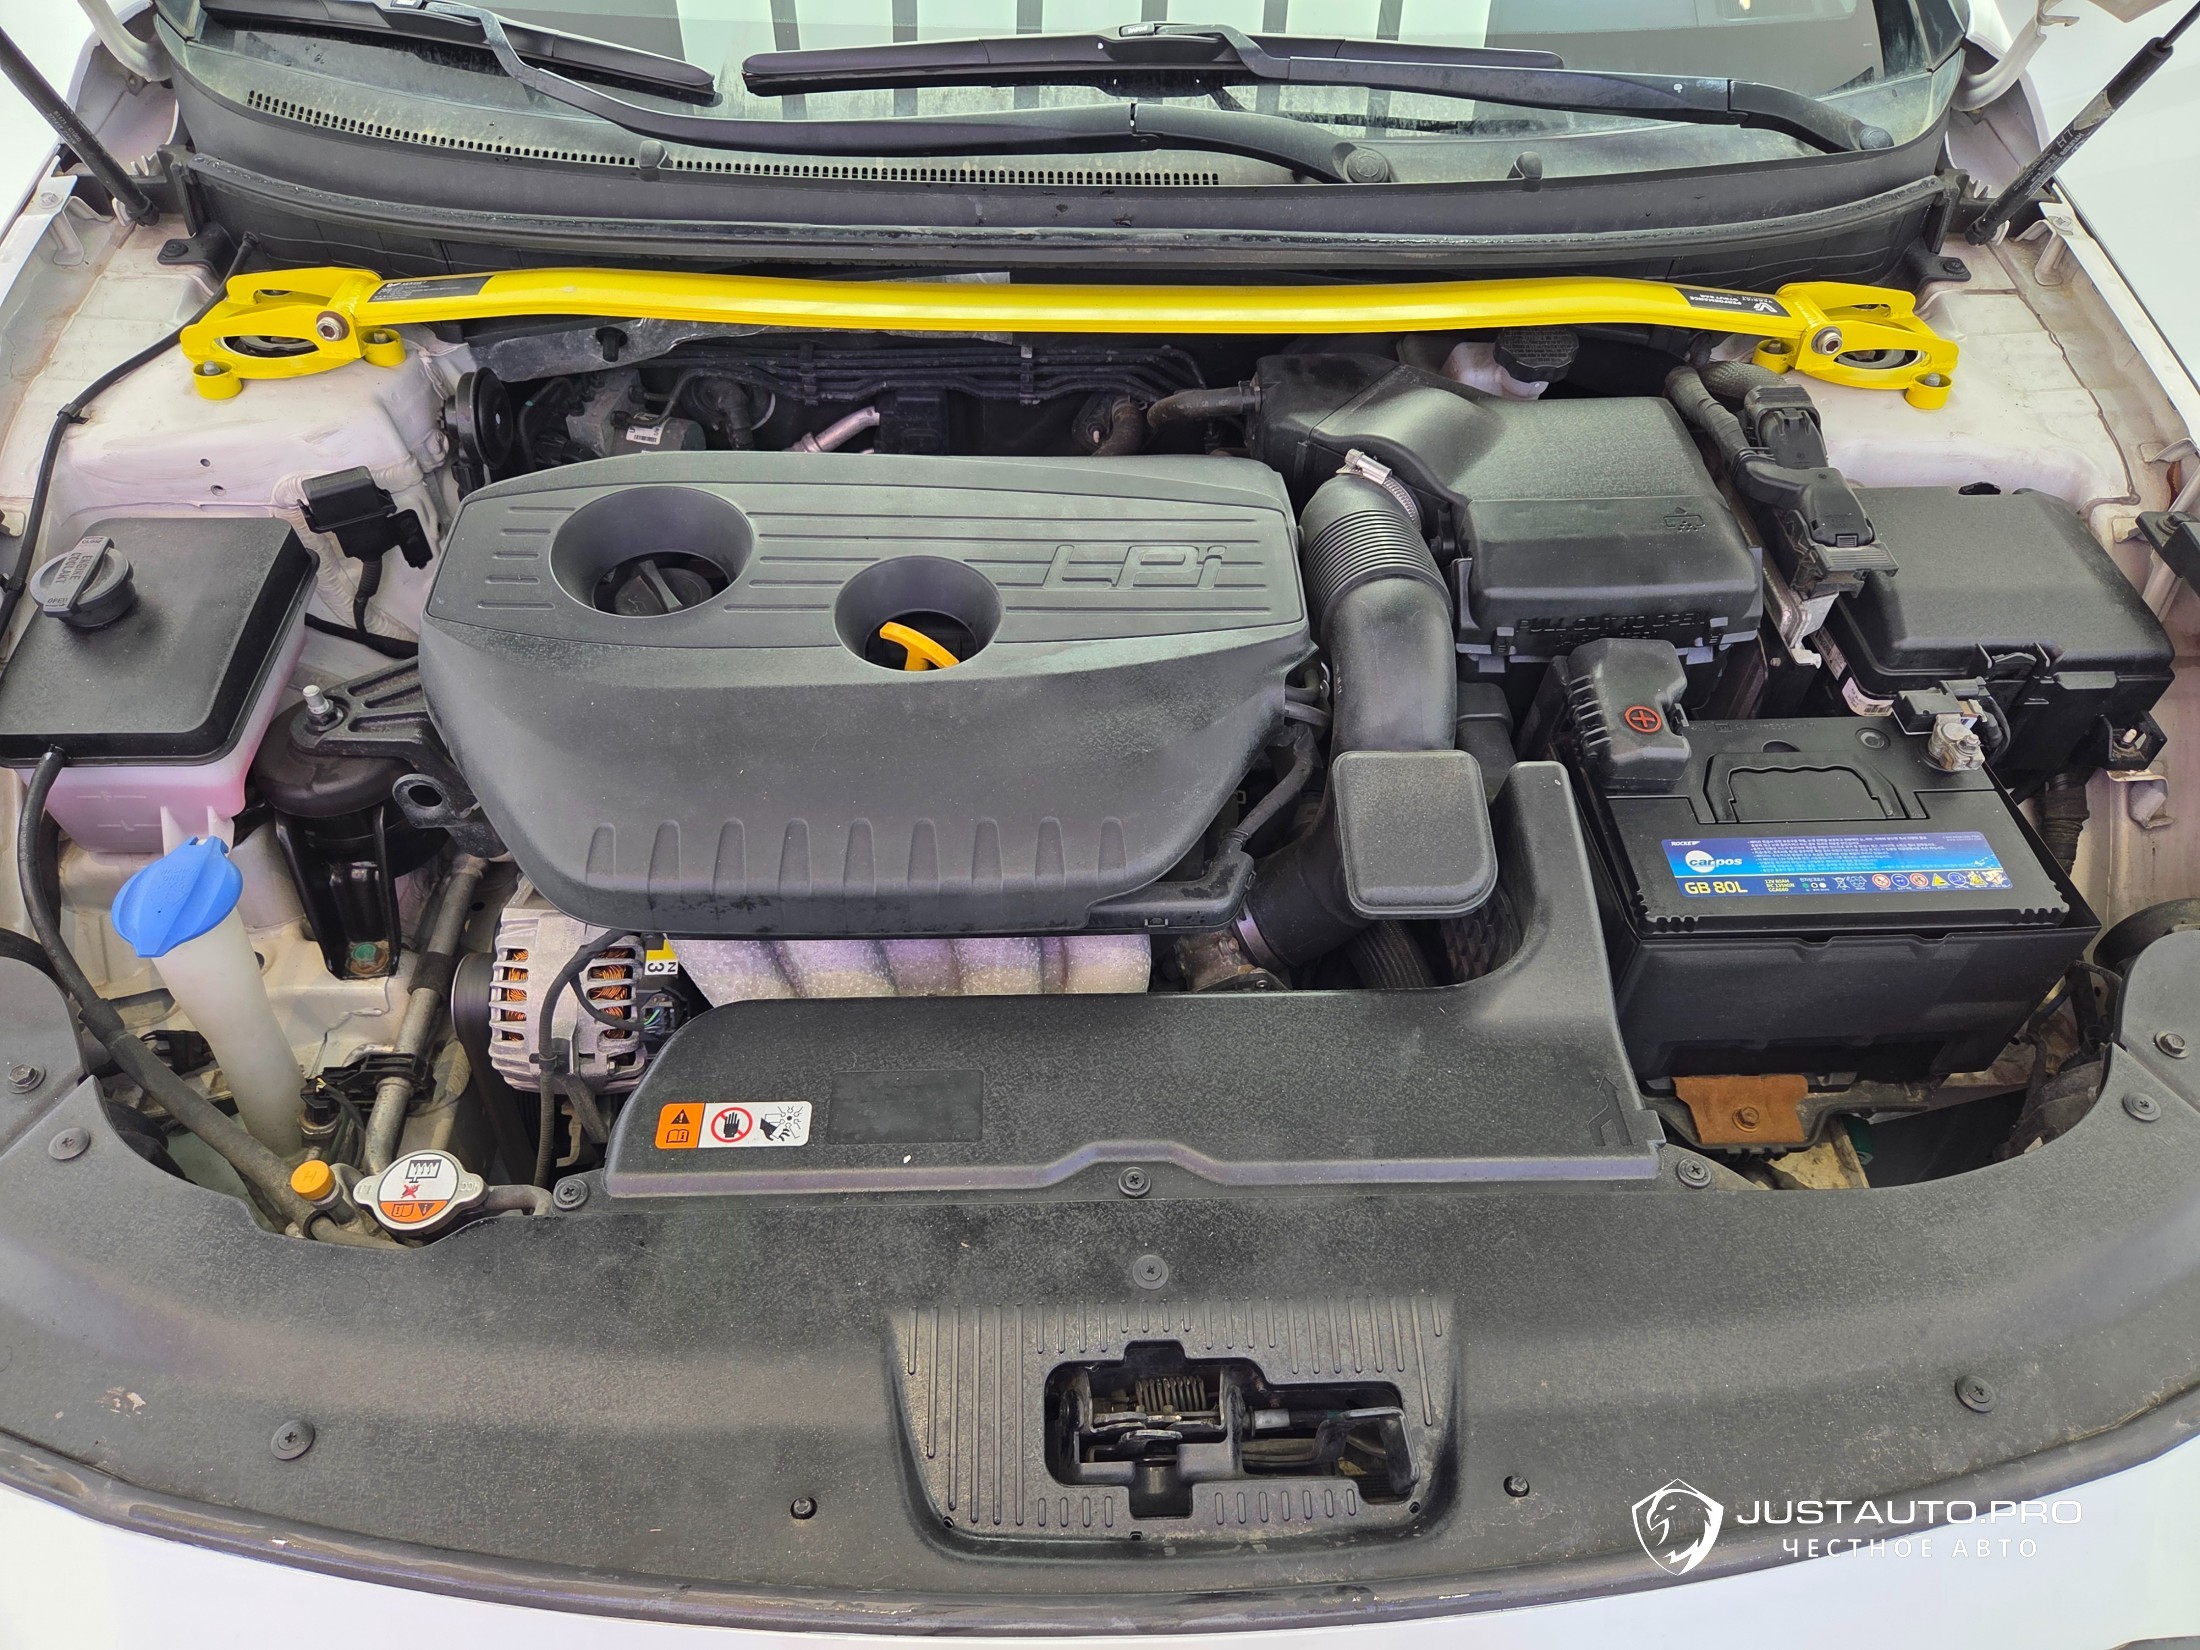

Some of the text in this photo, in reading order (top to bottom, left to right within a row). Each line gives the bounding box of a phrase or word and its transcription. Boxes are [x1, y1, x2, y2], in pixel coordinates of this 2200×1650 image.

[1043, 544, 1227, 590] LPi
[1519, 617, 1567, 632] PULL
[1573, 616, 1618, 631] OUT
[1689, 858, 1743, 868] carpos
[1684, 881, 1748, 894] GB 80L
[647, 962, 665, 973] 3
